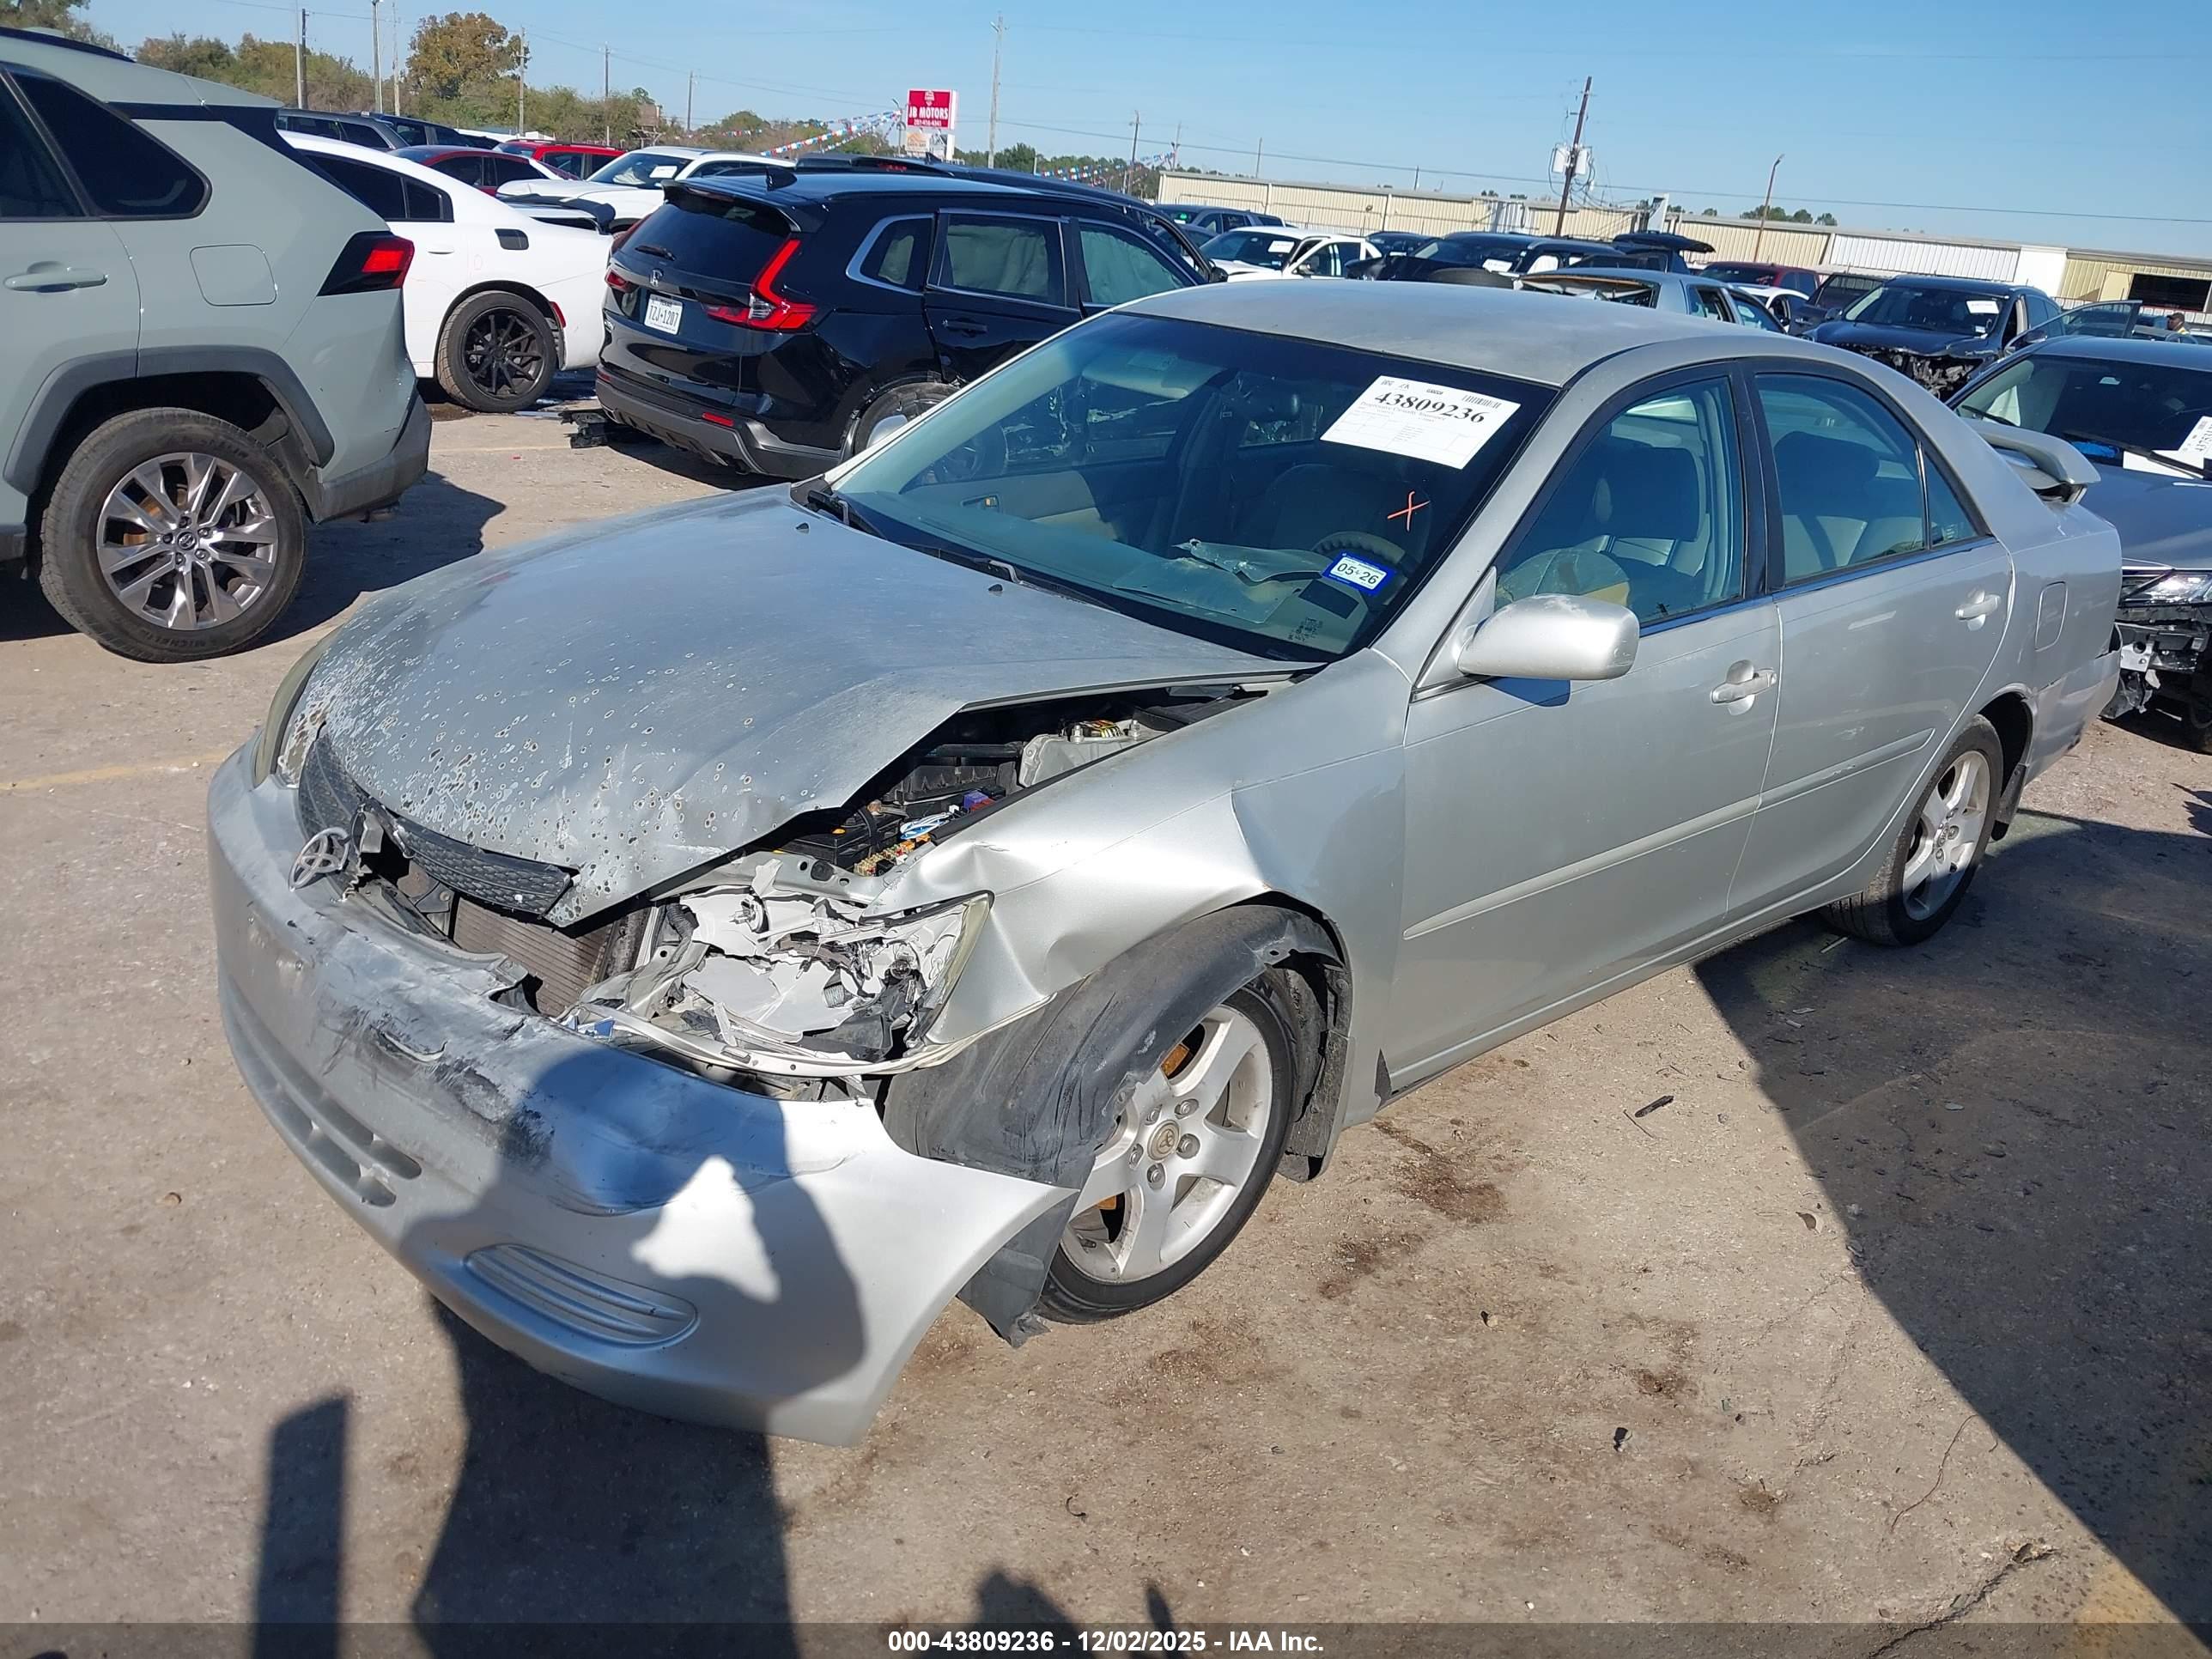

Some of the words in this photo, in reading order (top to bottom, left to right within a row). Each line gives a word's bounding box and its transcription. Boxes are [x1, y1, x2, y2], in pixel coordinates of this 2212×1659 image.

[908, 106, 918, 118] JB
[919, 106, 949, 120] MOTORS
[1375, 392, 1490, 423] 43809236
